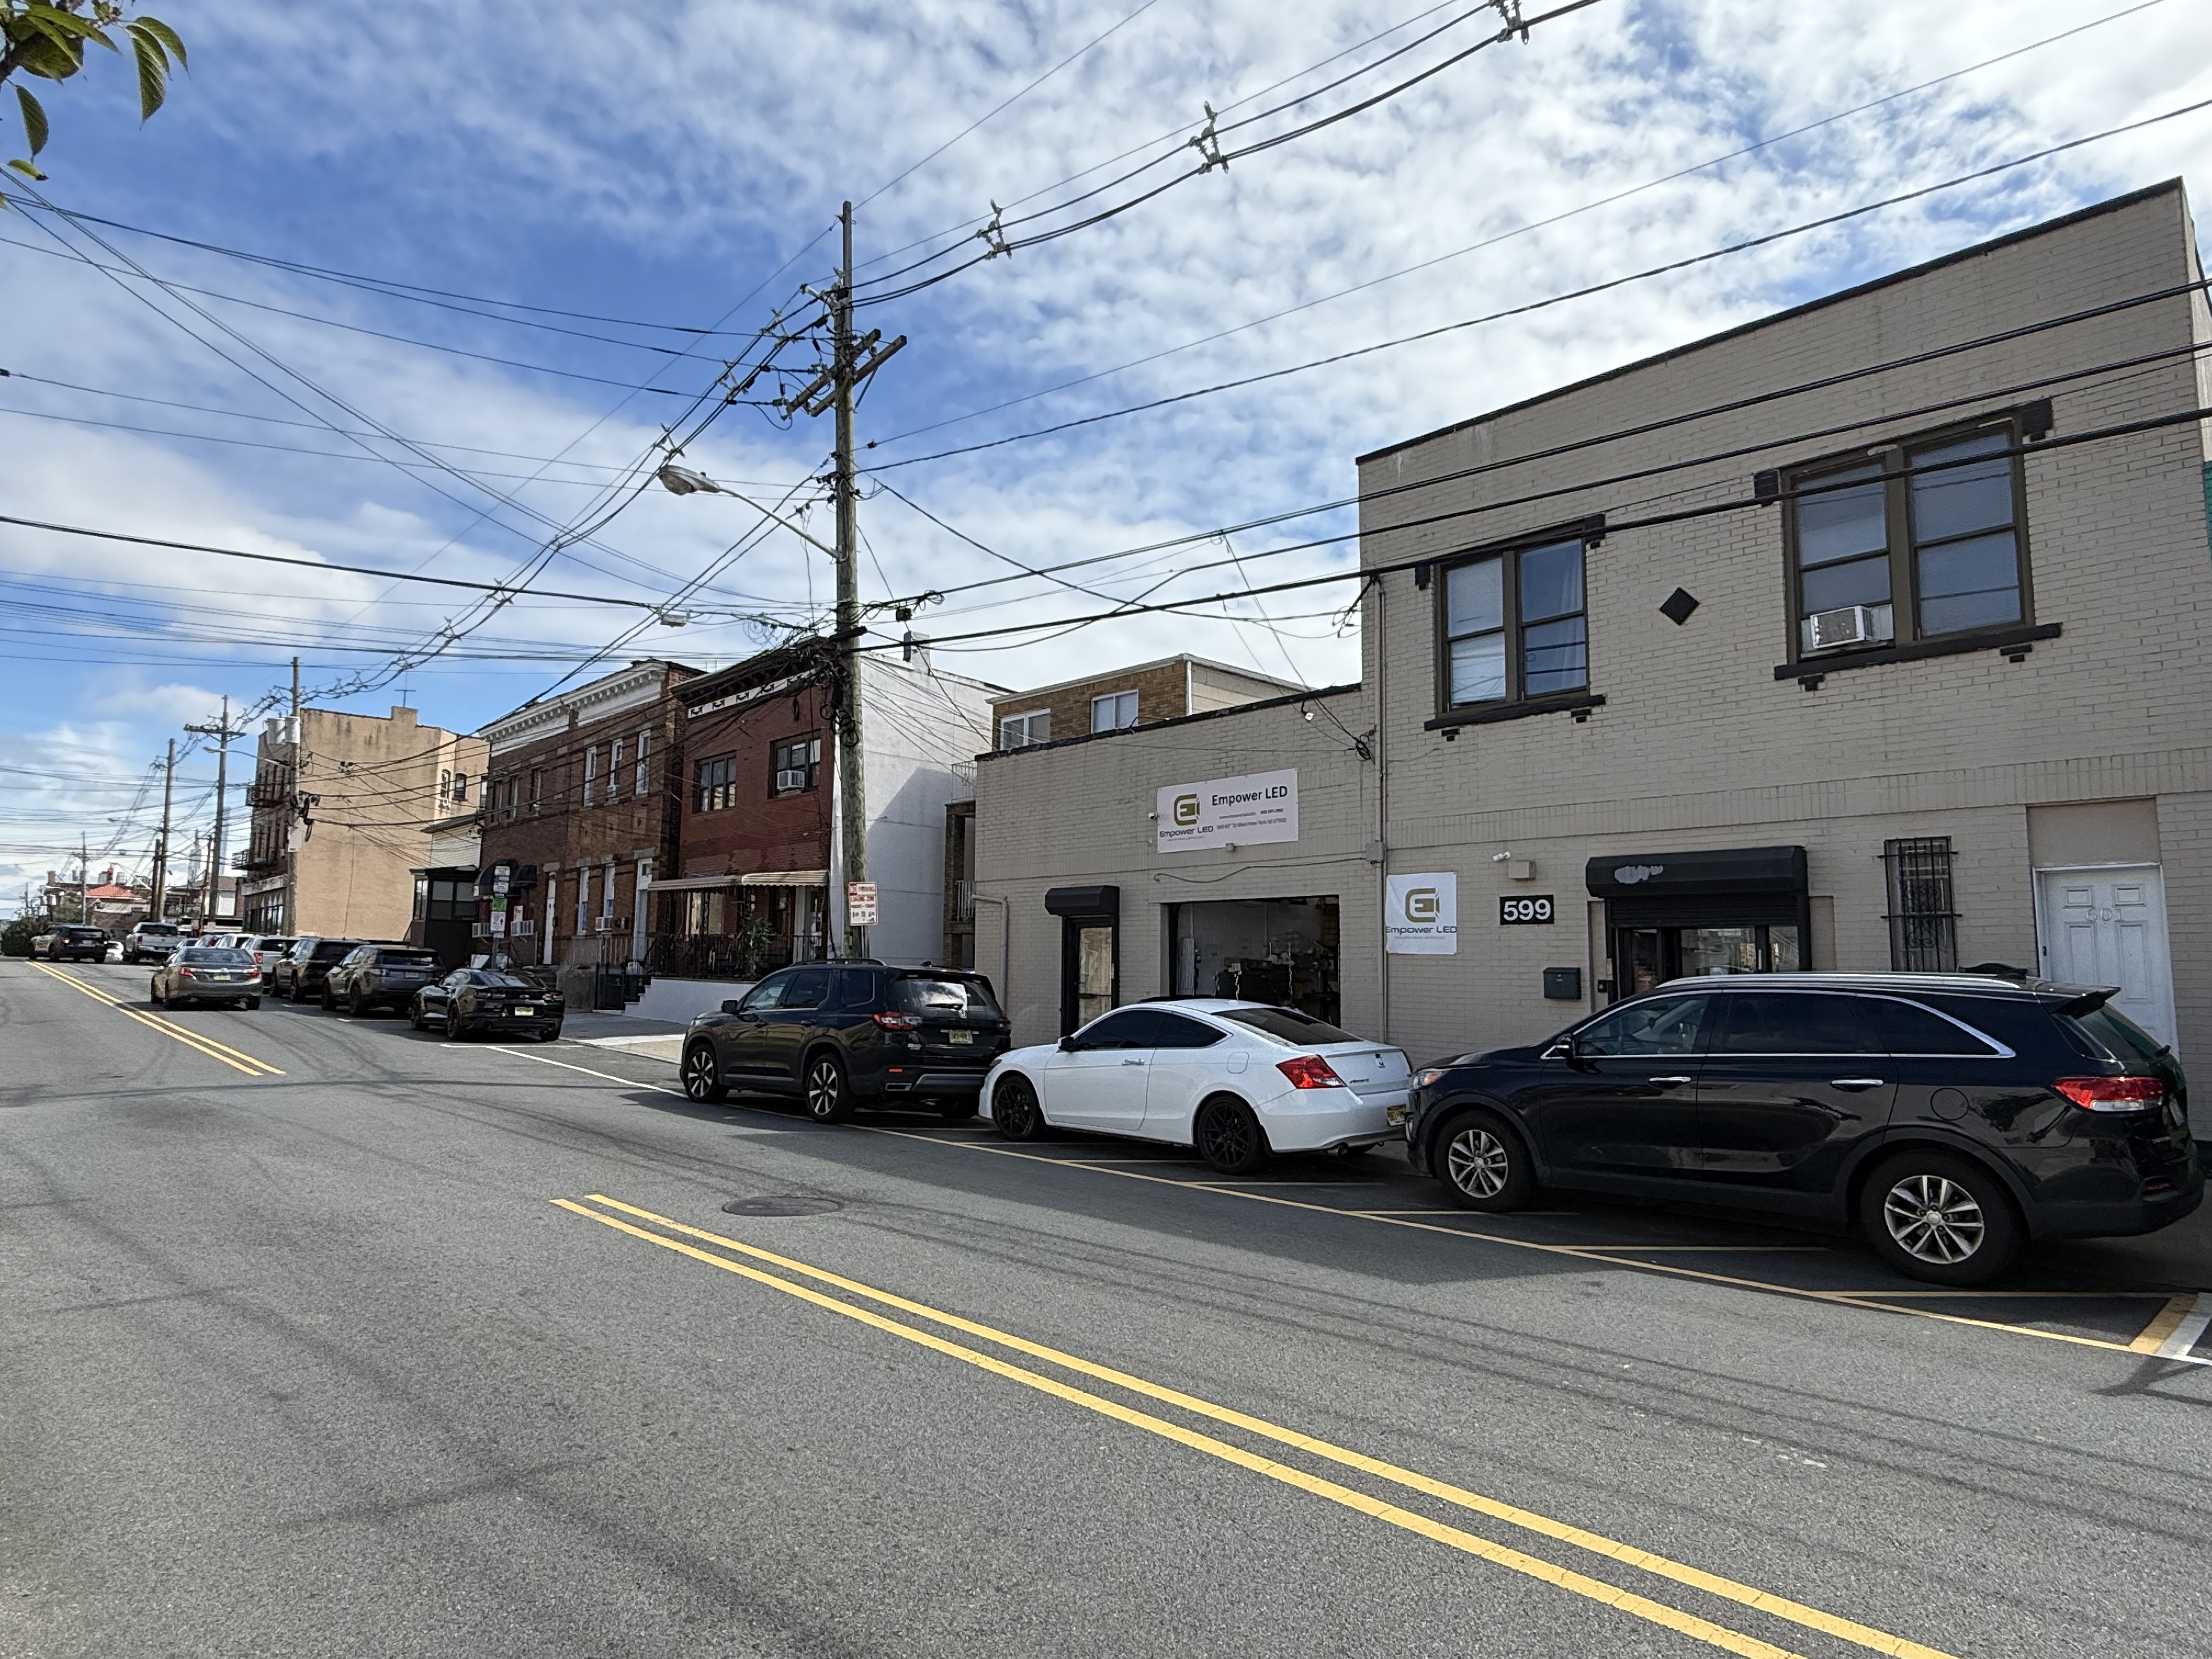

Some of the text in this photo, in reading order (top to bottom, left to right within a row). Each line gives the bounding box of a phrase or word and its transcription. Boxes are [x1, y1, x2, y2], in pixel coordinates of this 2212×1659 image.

[1212, 786, 1288, 806] Empower LED
[1160, 826, 1214, 838] Empower LED
[1503, 899, 1551, 921] 599
[2085, 907, 2125, 923] 601
[1385, 926, 1434, 935] Empower
